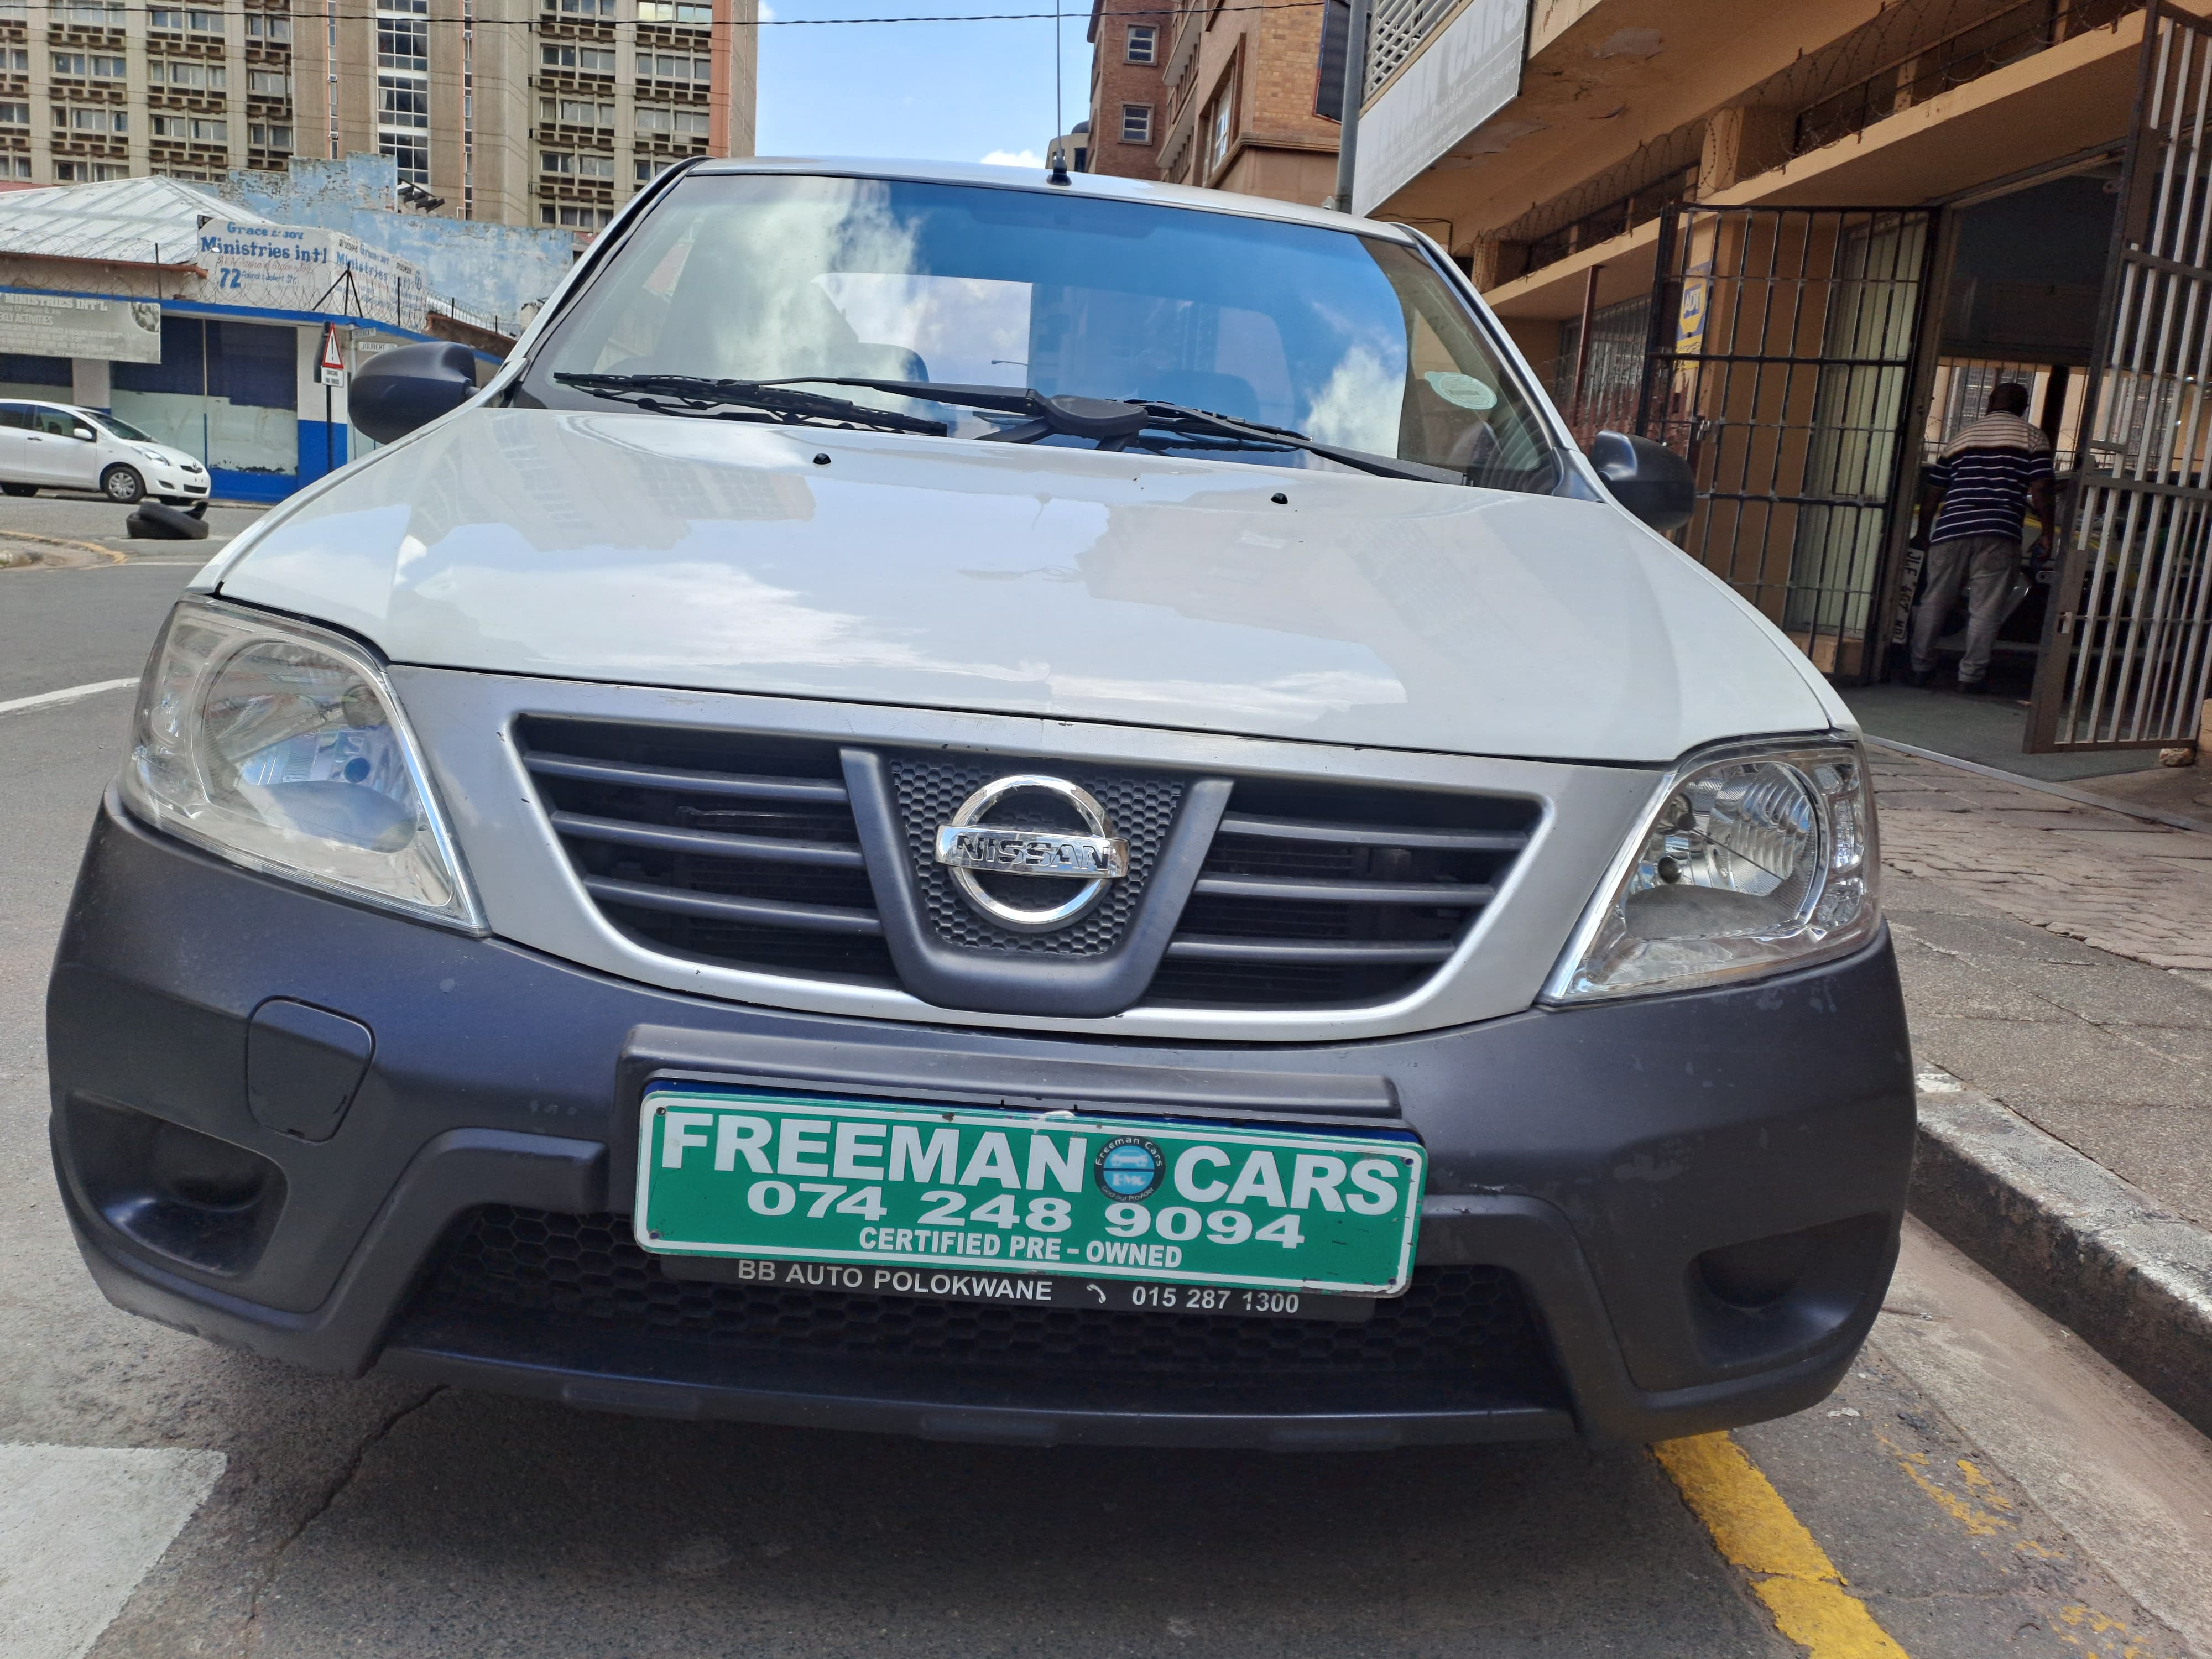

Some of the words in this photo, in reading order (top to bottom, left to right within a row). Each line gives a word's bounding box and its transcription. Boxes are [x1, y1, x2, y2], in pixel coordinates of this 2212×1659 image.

[227, 221, 268, 237] Grace
[201, 236, 290, 259] Ministries
[220, 268, 241, 289] 72
[4, 293, 73, 309] MINISTRIES
[1685, 288, 1702, 311] ADT
[15, 313, 53, 325] ACTIVITIES
[956, 834, 1110, 871] NISSAN
[662, 1112, 1087, 1193] FREEMAN
[1174, 1145, 1399, 1215] CARS
[1095, 1138, 1140, 1166] Freeman
[1145, 1141, 1162, 1167] Cars
[1129, 1187, 1155, 1202] Provider
[747, 1180, 888, 1222] 074
[917, 1190, 1072, 1233] 248
[1104, 1202, 1305, 1249] 9094
[859, 1227, 1000, 1256] CERTIFIED
[1009, 1236, 1062, 1260] PRE
[1086, 1240, 1183, 1269] OWNED
[738, 1260, 776, 1281] BB
[785, 1263, 863, 1288] AUTO
[874, 1270, 1053, 1301] POLOKWANE
[1132, 1286, 1176, 1308] 015
[1186, 1287, 1231, 1310] 287
[1242, 1291, 1300, 1314] 1300
